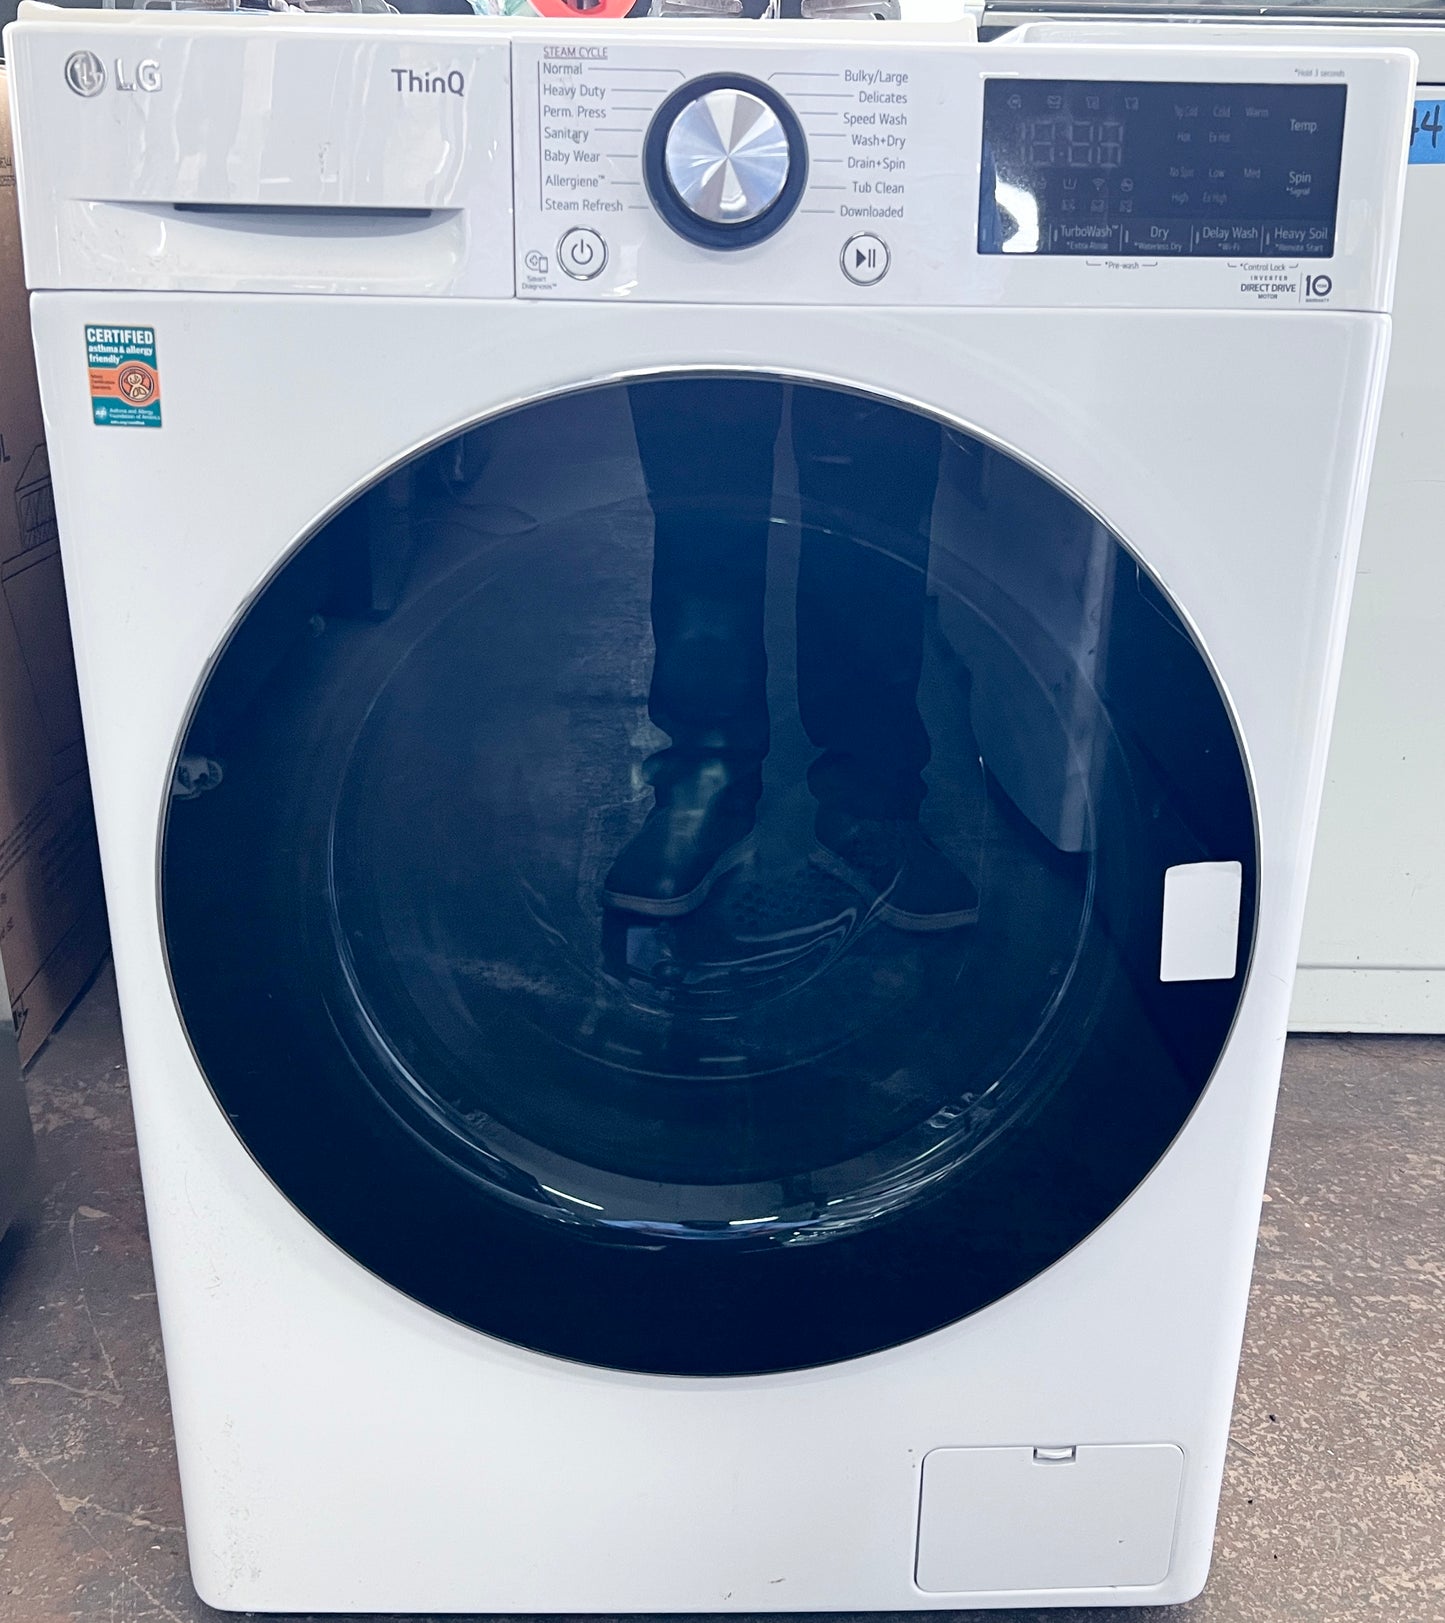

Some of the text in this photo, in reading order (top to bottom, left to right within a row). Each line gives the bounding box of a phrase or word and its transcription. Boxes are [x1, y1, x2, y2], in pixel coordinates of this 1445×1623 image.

[543, 47, 608, 58] STEAM CYCLE
[116, 58, 163, 93] LG
[543, 63, 582, 75] Normal
[391, 68, 465, 98] ThinQ
[844, 69, 909, 86] Bulky/Large
[543, 84, 606, 100] Heavy Duty
[859, 91, 908, 104] Delicates
[543, 106, 606, 118] Perm. Press
[843, 112, 908, 127] Speed Wash
[1246, 107, 1269, 118] Warm
[1290, 118, 1318, 135] Temp
[544, 127, 589, 142] Sanitary
[851, 134, 906, 150] Wash+Dry
[544, 150, 600, 165] Baby Wear
[848, 156, 906, 172] Drain+Spin
[1288, 171, 1312, 186] Spin
[852, 181, 904, 194] Tub Clean
[545, 199, 623, 212] Steam Refresh
[840, 204, 904, 218] Downloaded
[1150, 226, 1170, 240] Dry
[1202, 226, 1258, 241] Delay Wash
[1274, 227, 1328, 242] Heavy Soil
[1270, 262, 1286, 272] Lock
[1240, 284, 1296, 292] DIRECT DRIVE
[1306, 274, 1332, 297] 10
[86, 328, 154, 345] CERTIFIED
[88, 344, 153, 356] asthma & allergy
